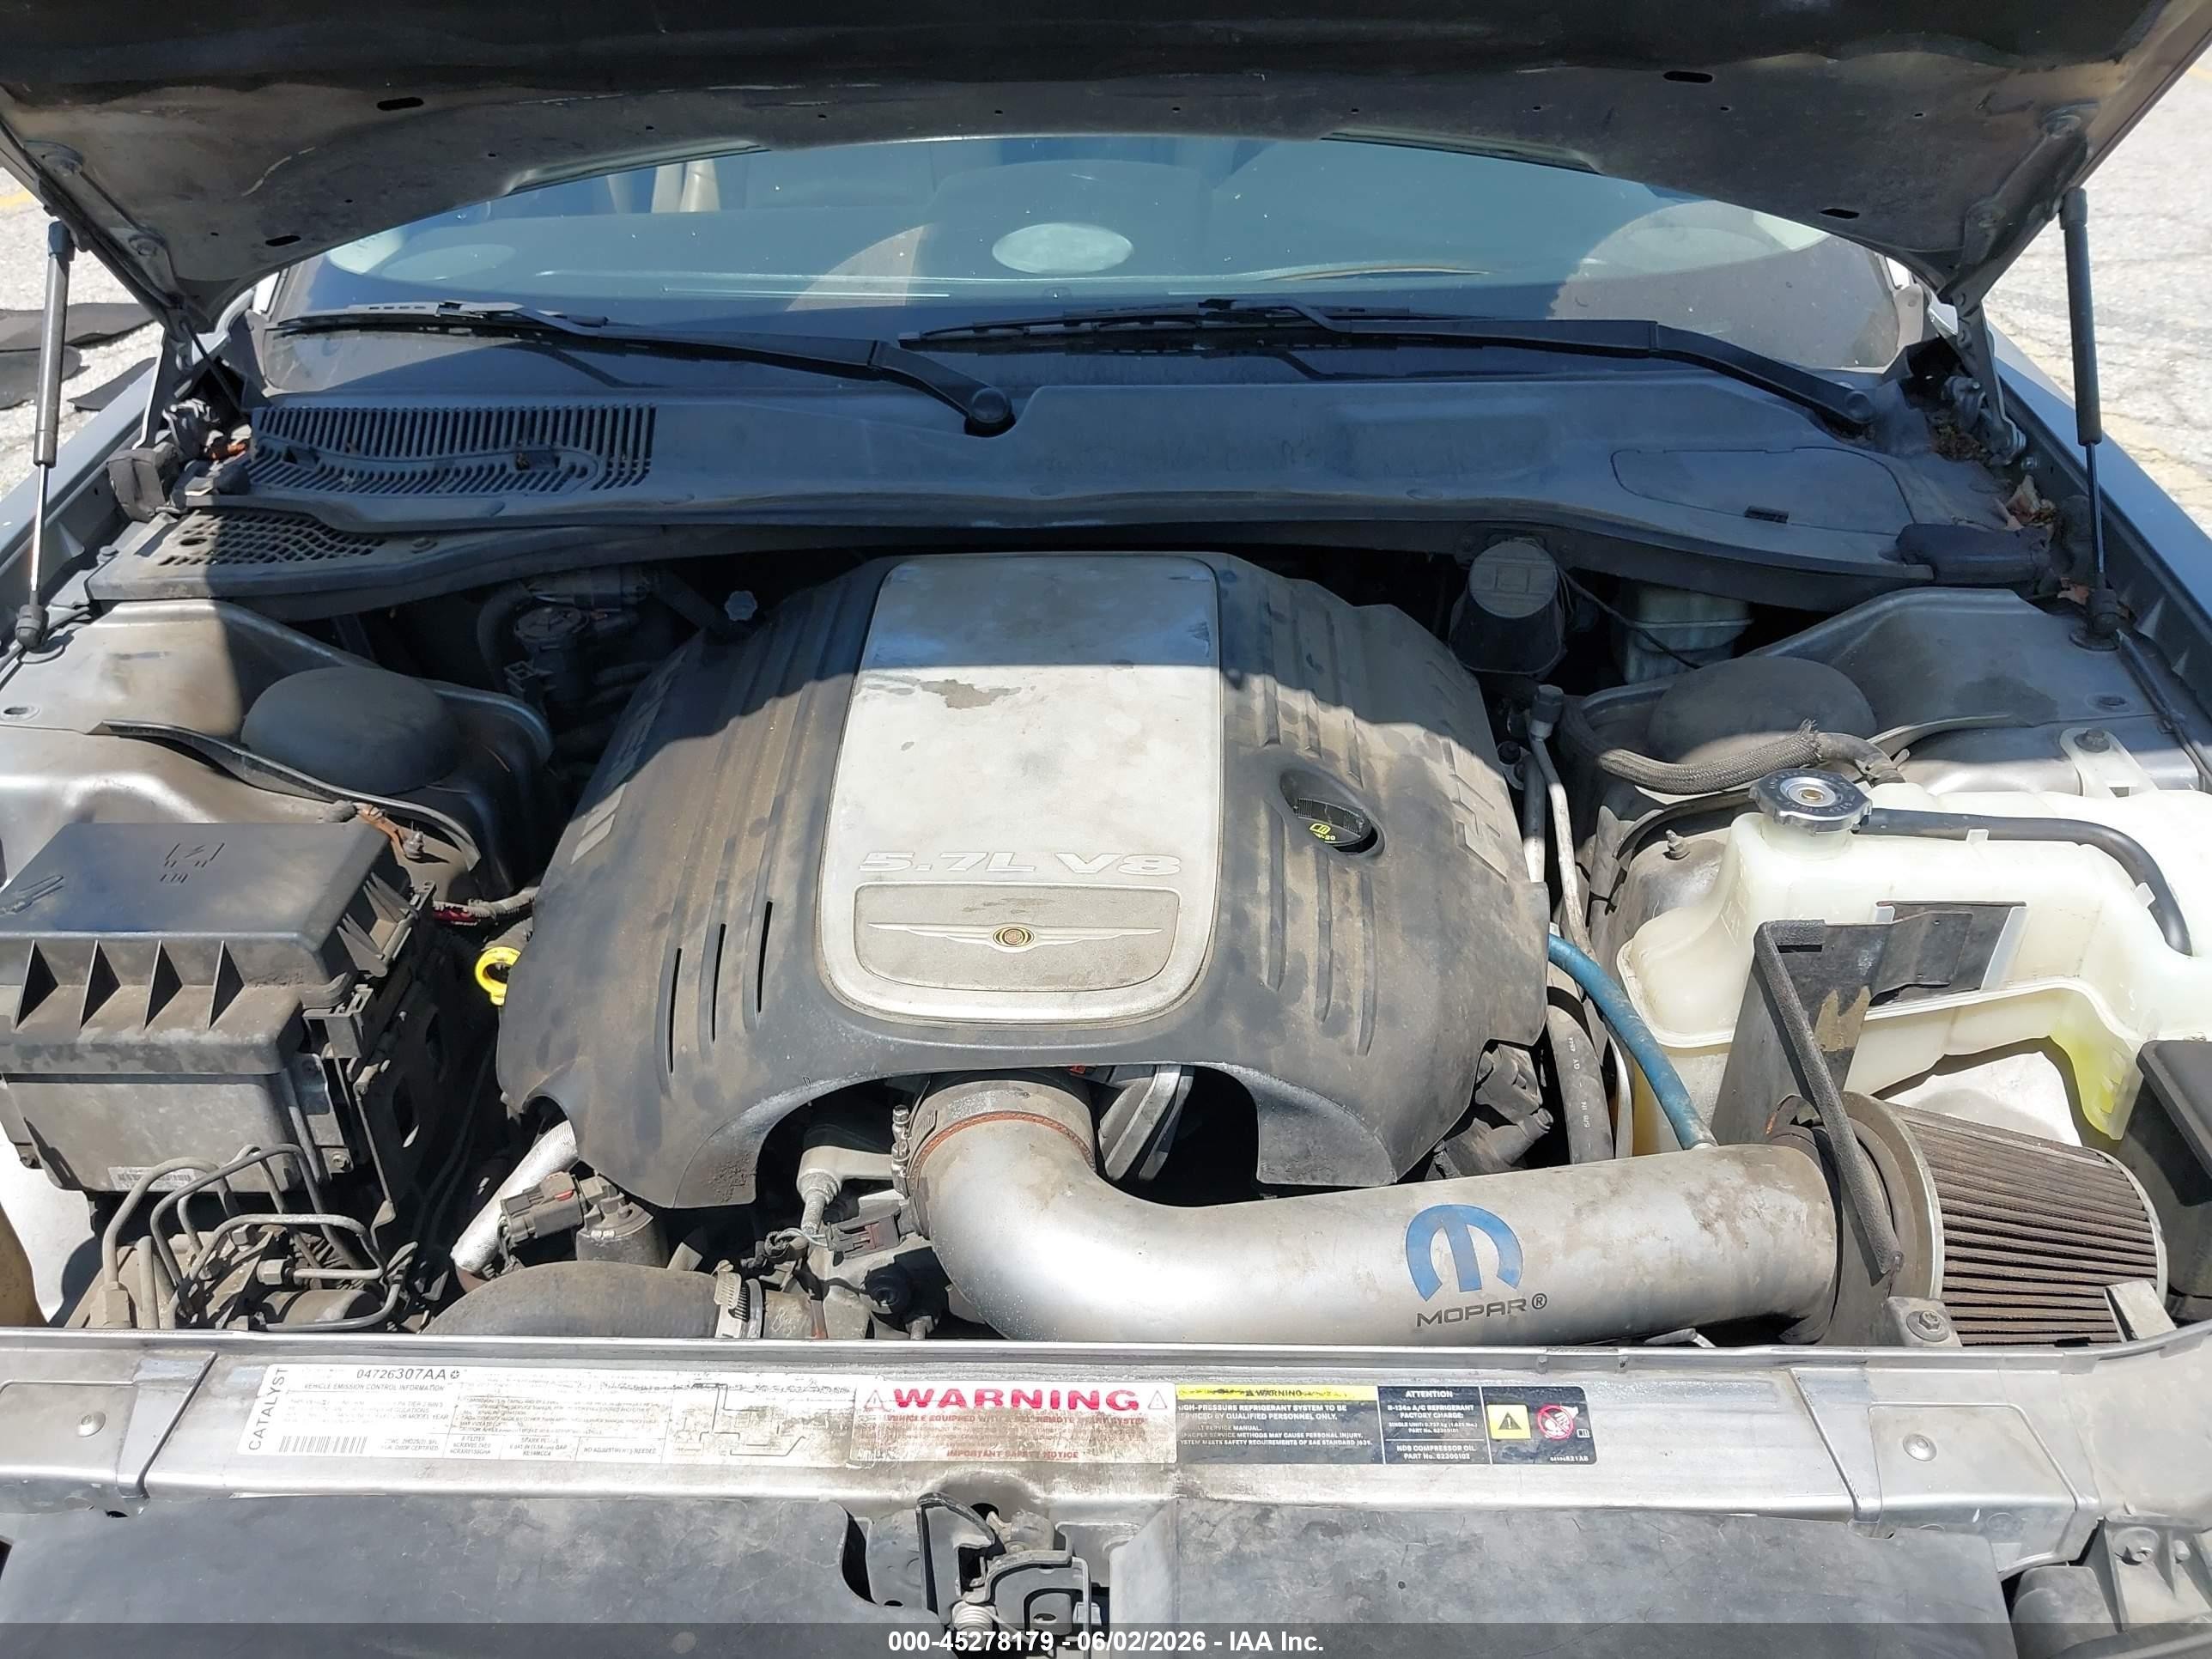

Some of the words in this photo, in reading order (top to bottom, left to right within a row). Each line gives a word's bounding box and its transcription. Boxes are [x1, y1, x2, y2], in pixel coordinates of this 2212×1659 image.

[858, 852, 1036, 874] 5.7L
[1056, 852, 1182, 874] V8
[356, 1367, 447, 1381] 04726307AA
[248, 1367, 289, 1451] CATALYST
[893, 1389, 1139, 1411] WARNING
